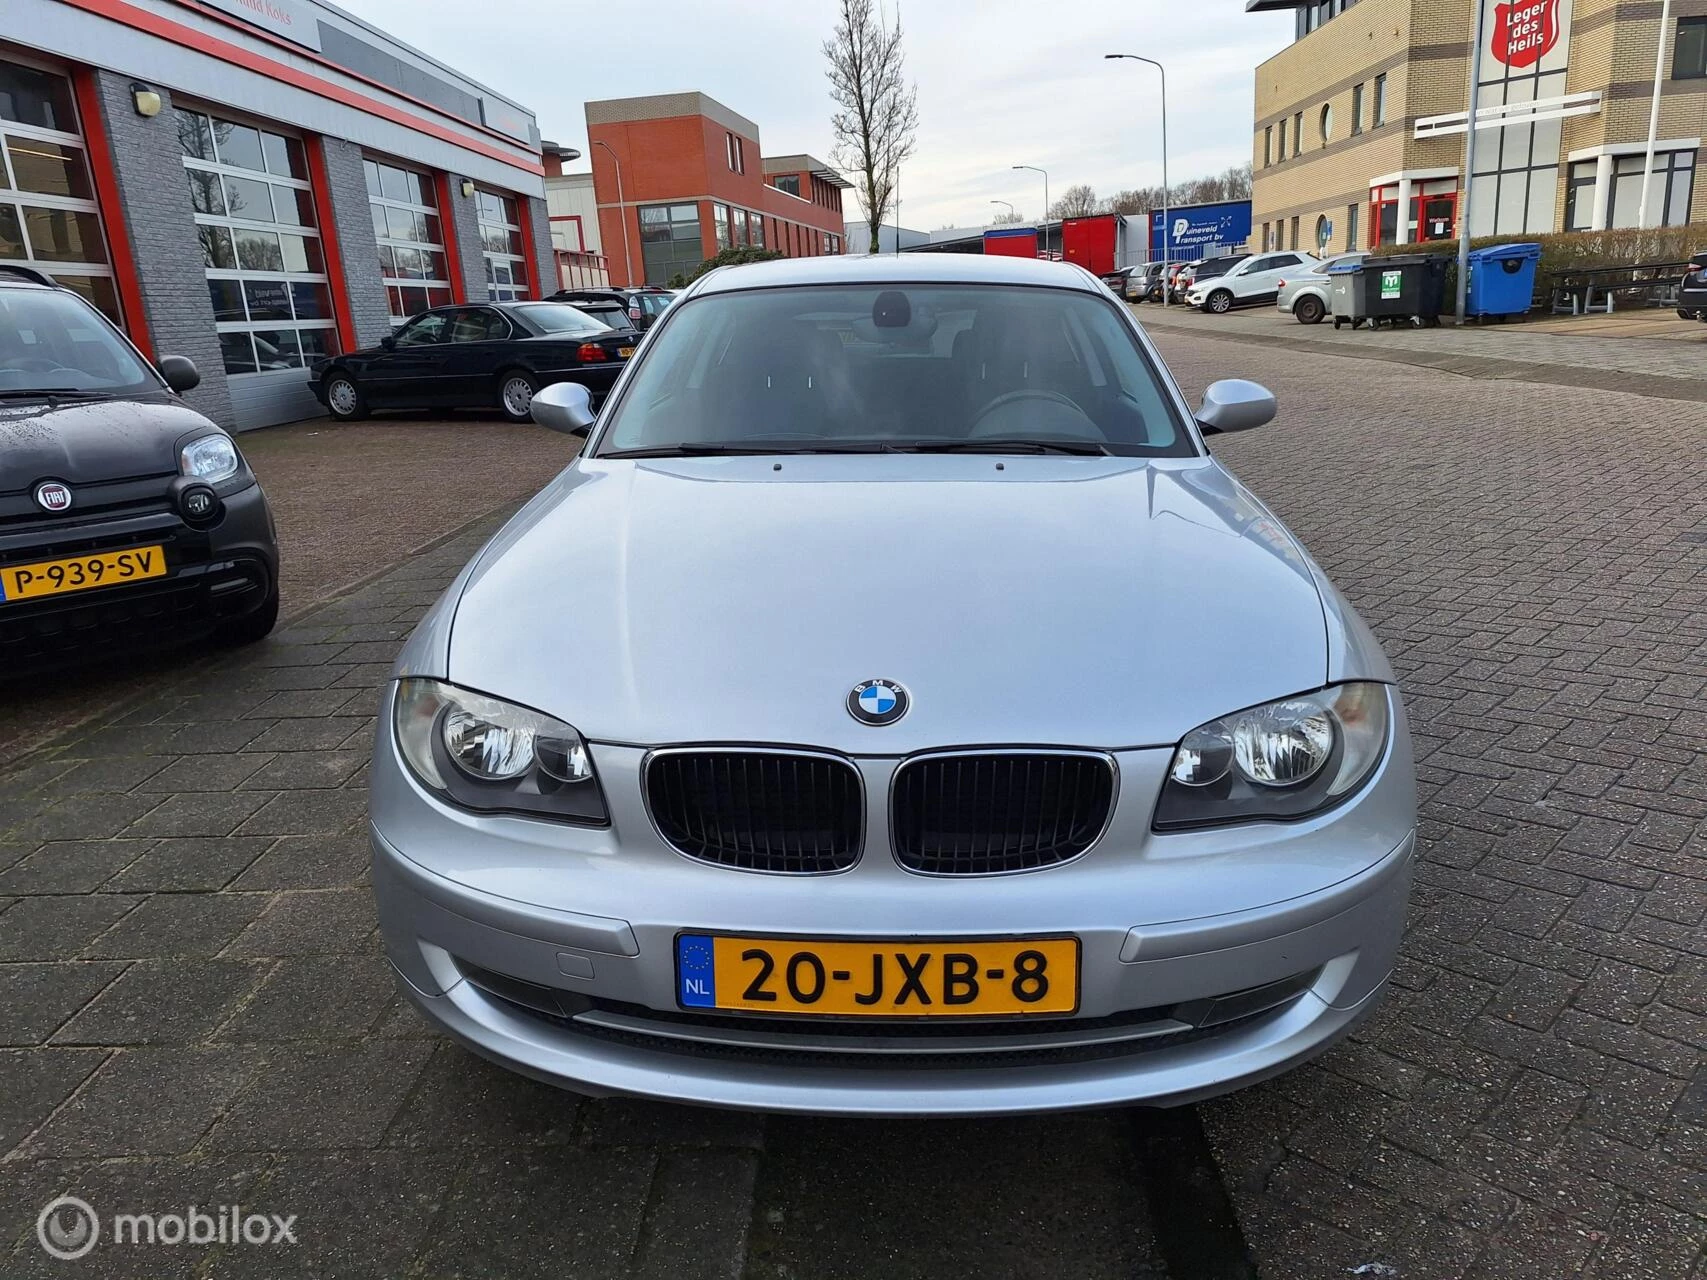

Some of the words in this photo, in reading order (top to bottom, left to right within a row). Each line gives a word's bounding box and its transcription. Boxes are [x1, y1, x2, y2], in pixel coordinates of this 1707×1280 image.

[1506, 1, 1548, 26] Leger
[1513, 20, 1538, 38] des
[1508, 33, 1544, 55] Heils
[1172, 219, 1218, 237] Duineveld
[1175, 234, 1213, 244] Transport
[44, 491, 65, 505] FIAT
[15, 551, 151, 593] P-939-SV
[854, 680, 902, 693] BMW
[685, 979, 710, 995] NL
[742, 949, 1049, 1005] 20-JXB-8
